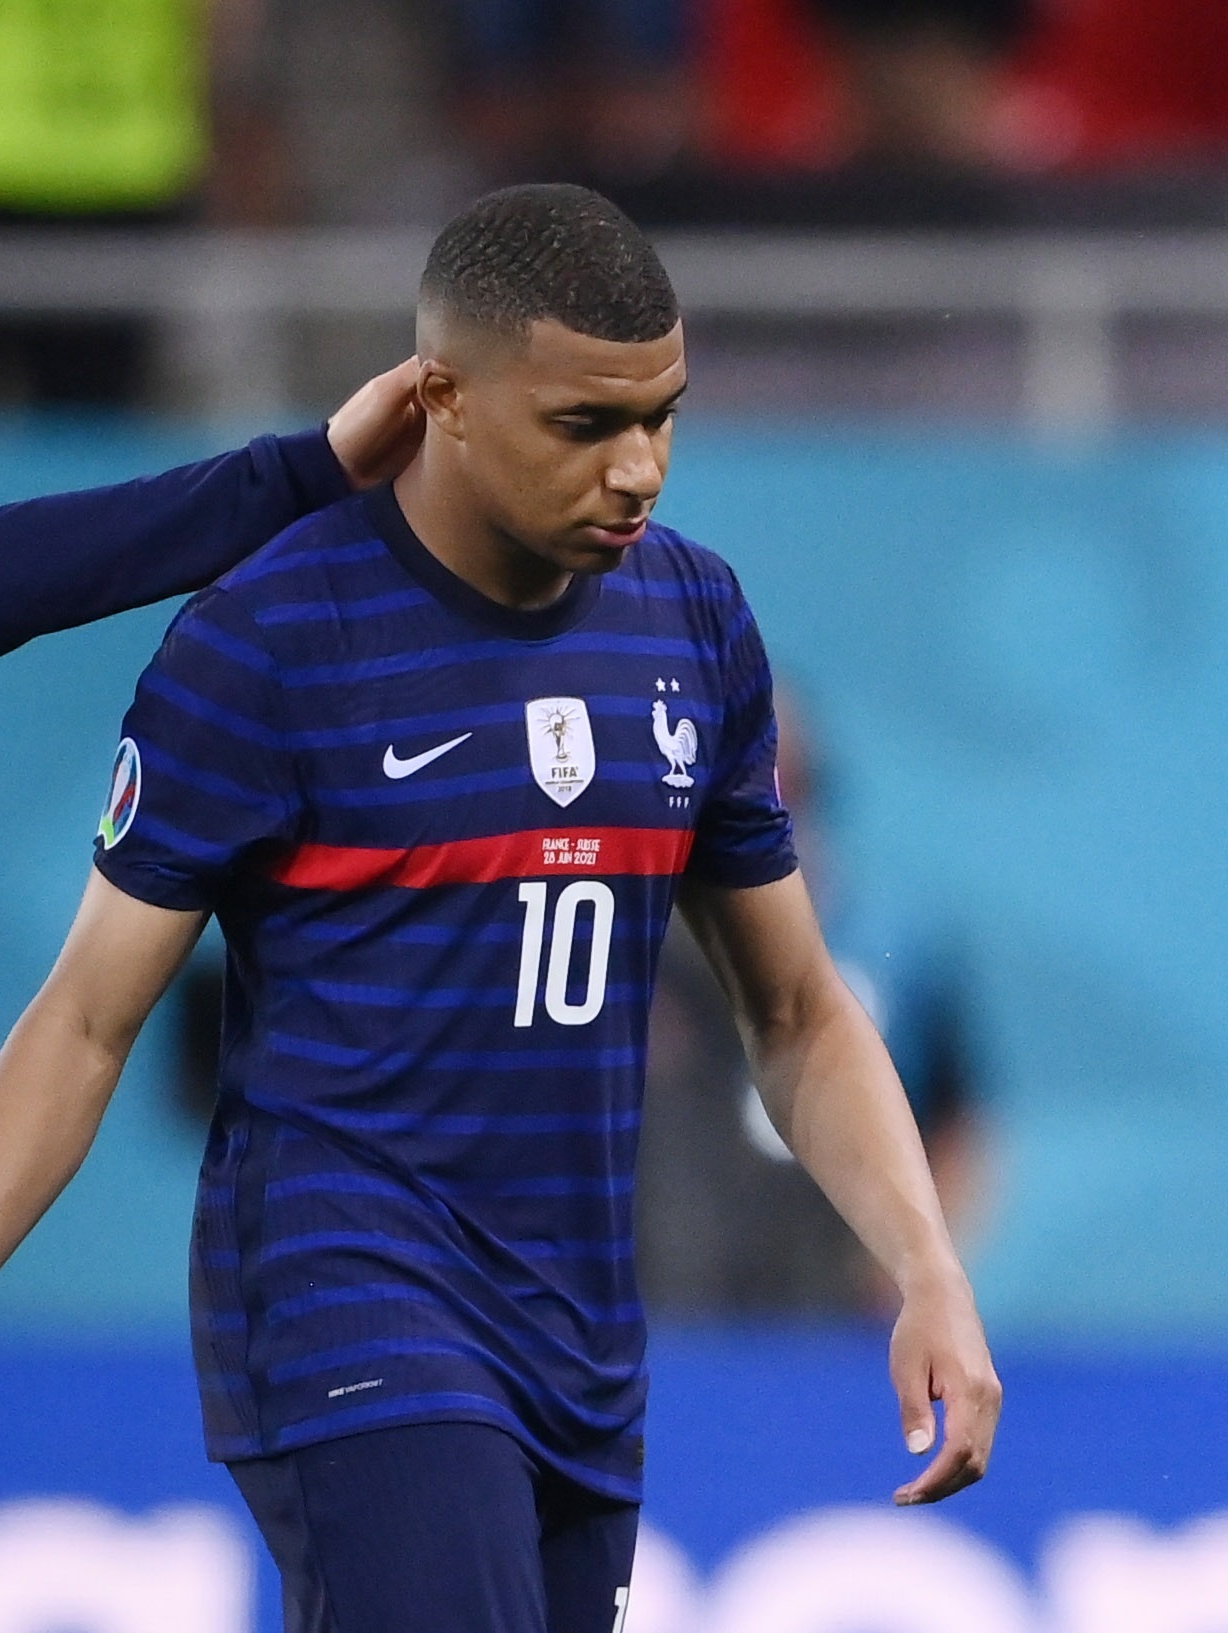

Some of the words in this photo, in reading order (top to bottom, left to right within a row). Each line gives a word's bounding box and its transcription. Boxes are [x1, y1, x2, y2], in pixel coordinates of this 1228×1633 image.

[552, 767, 578, 778] FIFA
[542, 838, 570, 851] FRANCE
[543, 851, 555, 865] 28
[574, 852, 596, 865] 2021
[514, 881, 614, 1027] 10
